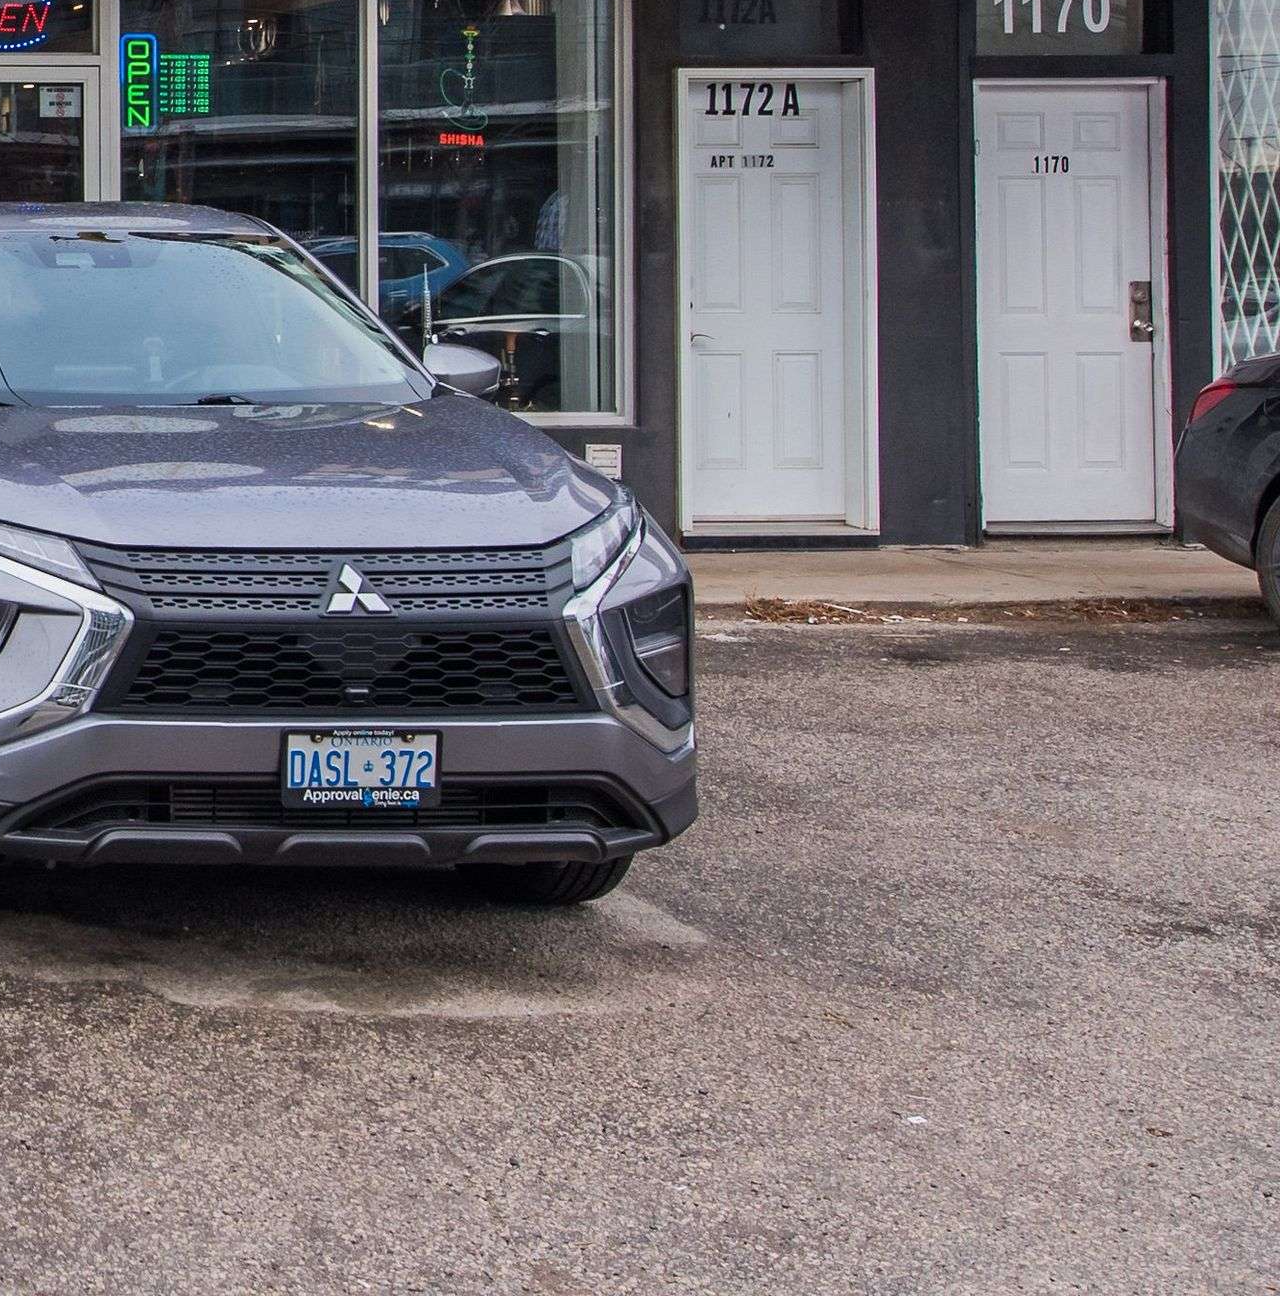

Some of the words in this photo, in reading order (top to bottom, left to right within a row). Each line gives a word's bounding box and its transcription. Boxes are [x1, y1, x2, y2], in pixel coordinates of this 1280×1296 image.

[127, 40, 151, 128] OPEN
[705, 83, 774, 116] 1172
[781, 83, 800, 116] A
[439, 133, 485, 146] SHISHA
[710, 155, 735, 168] APT
[742, 155, 775, 168] 1172
[1034, 156, 1070, 174] 1170
[331, 736, 393, 748] ONTARIO
[290, 750, 359, 787] DASL
[379, 750, 433, 787] 372
